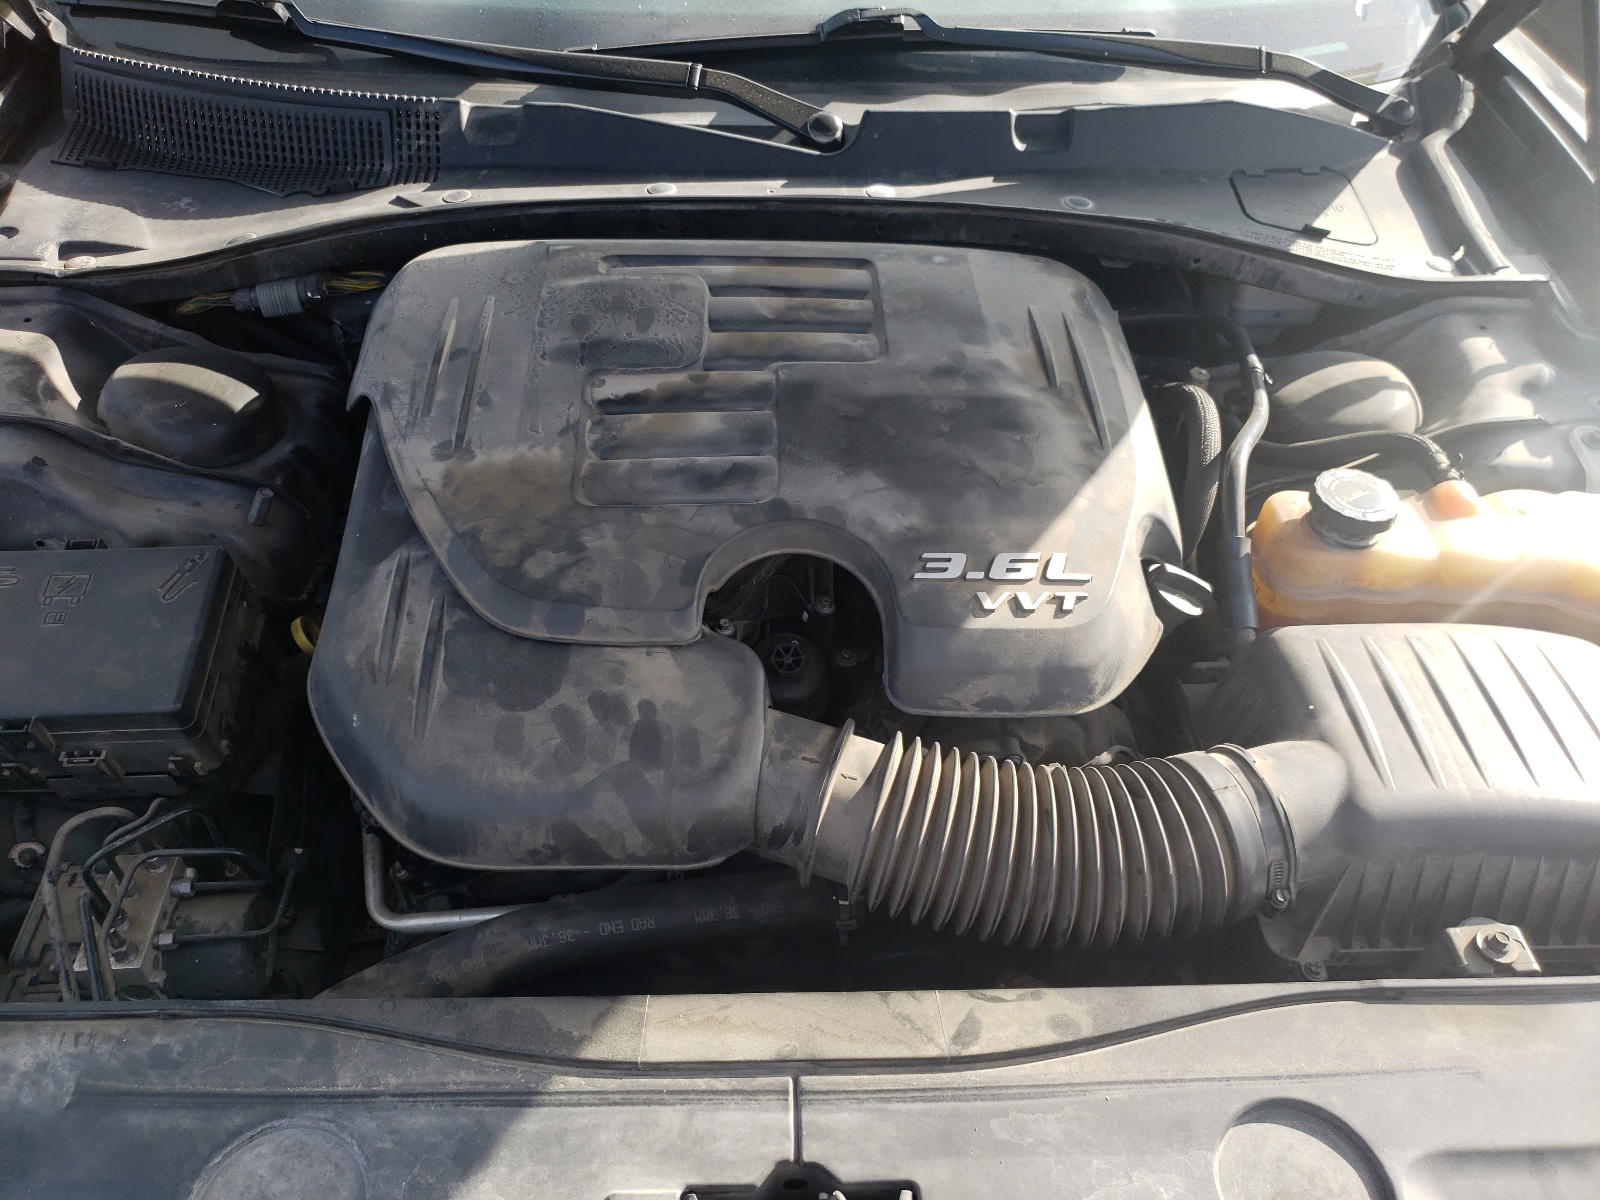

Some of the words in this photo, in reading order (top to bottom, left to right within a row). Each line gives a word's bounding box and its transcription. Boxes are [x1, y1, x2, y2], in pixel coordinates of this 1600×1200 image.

[912, 552, 1092, 581] 3.6L
[974, 591, 1089, 613] VVT
[599, 920, 625, 936] END
[630, 916, 656, 932] RAD
